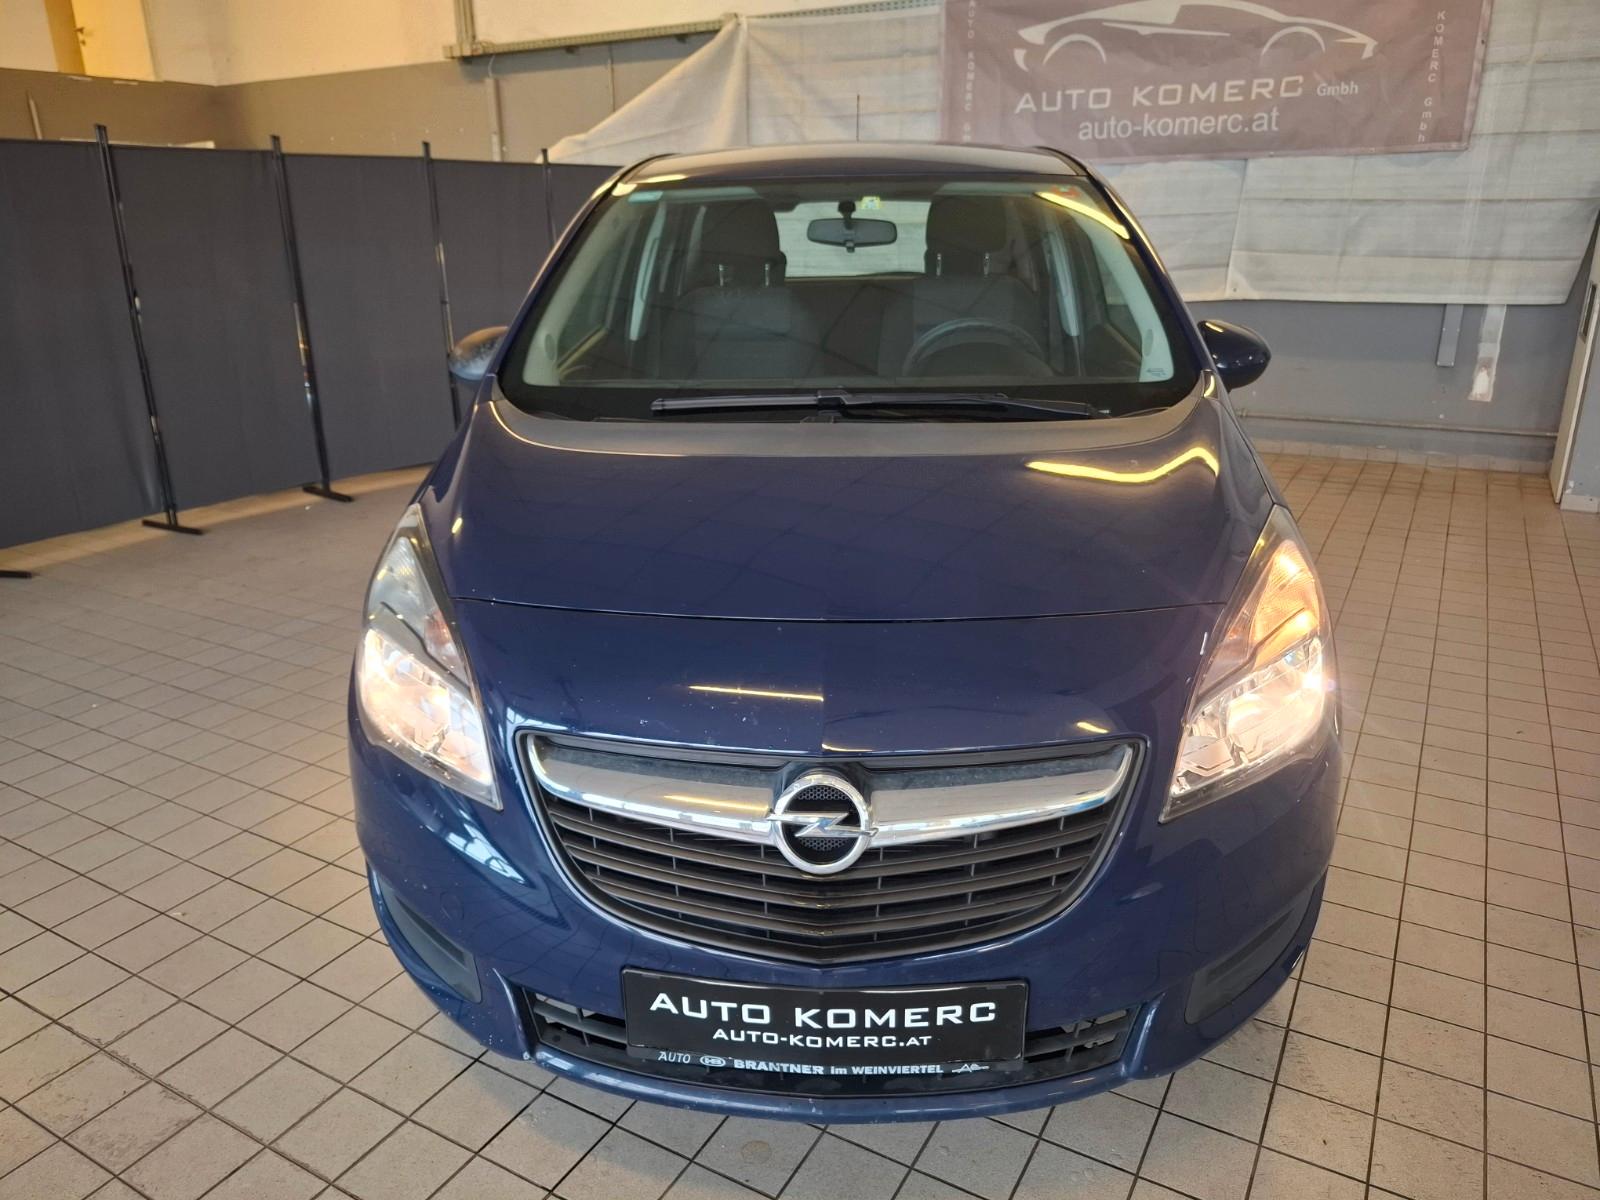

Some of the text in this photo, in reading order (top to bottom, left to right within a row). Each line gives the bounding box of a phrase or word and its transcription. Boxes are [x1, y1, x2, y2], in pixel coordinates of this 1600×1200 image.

[1418, 10, 1446, 142] KOMERC Gmbh
[1014, 75, 1359, 114] AUTO KOMERC Gmbh
[1078, 106, 1279, 140] auto-komerc.at
[650, 992, 996, 1029] AUTO KOMERC
[712, 1028, 932, 1048] AUTO-KOMERC.AT
[658, 1051, 691, 1064] AUTO
[733, 1059, 825, 1075] BRANTNER
[830, 1065, 848, 1075] im
[852, 1064, 944, 1075] WEINVIERTEL
